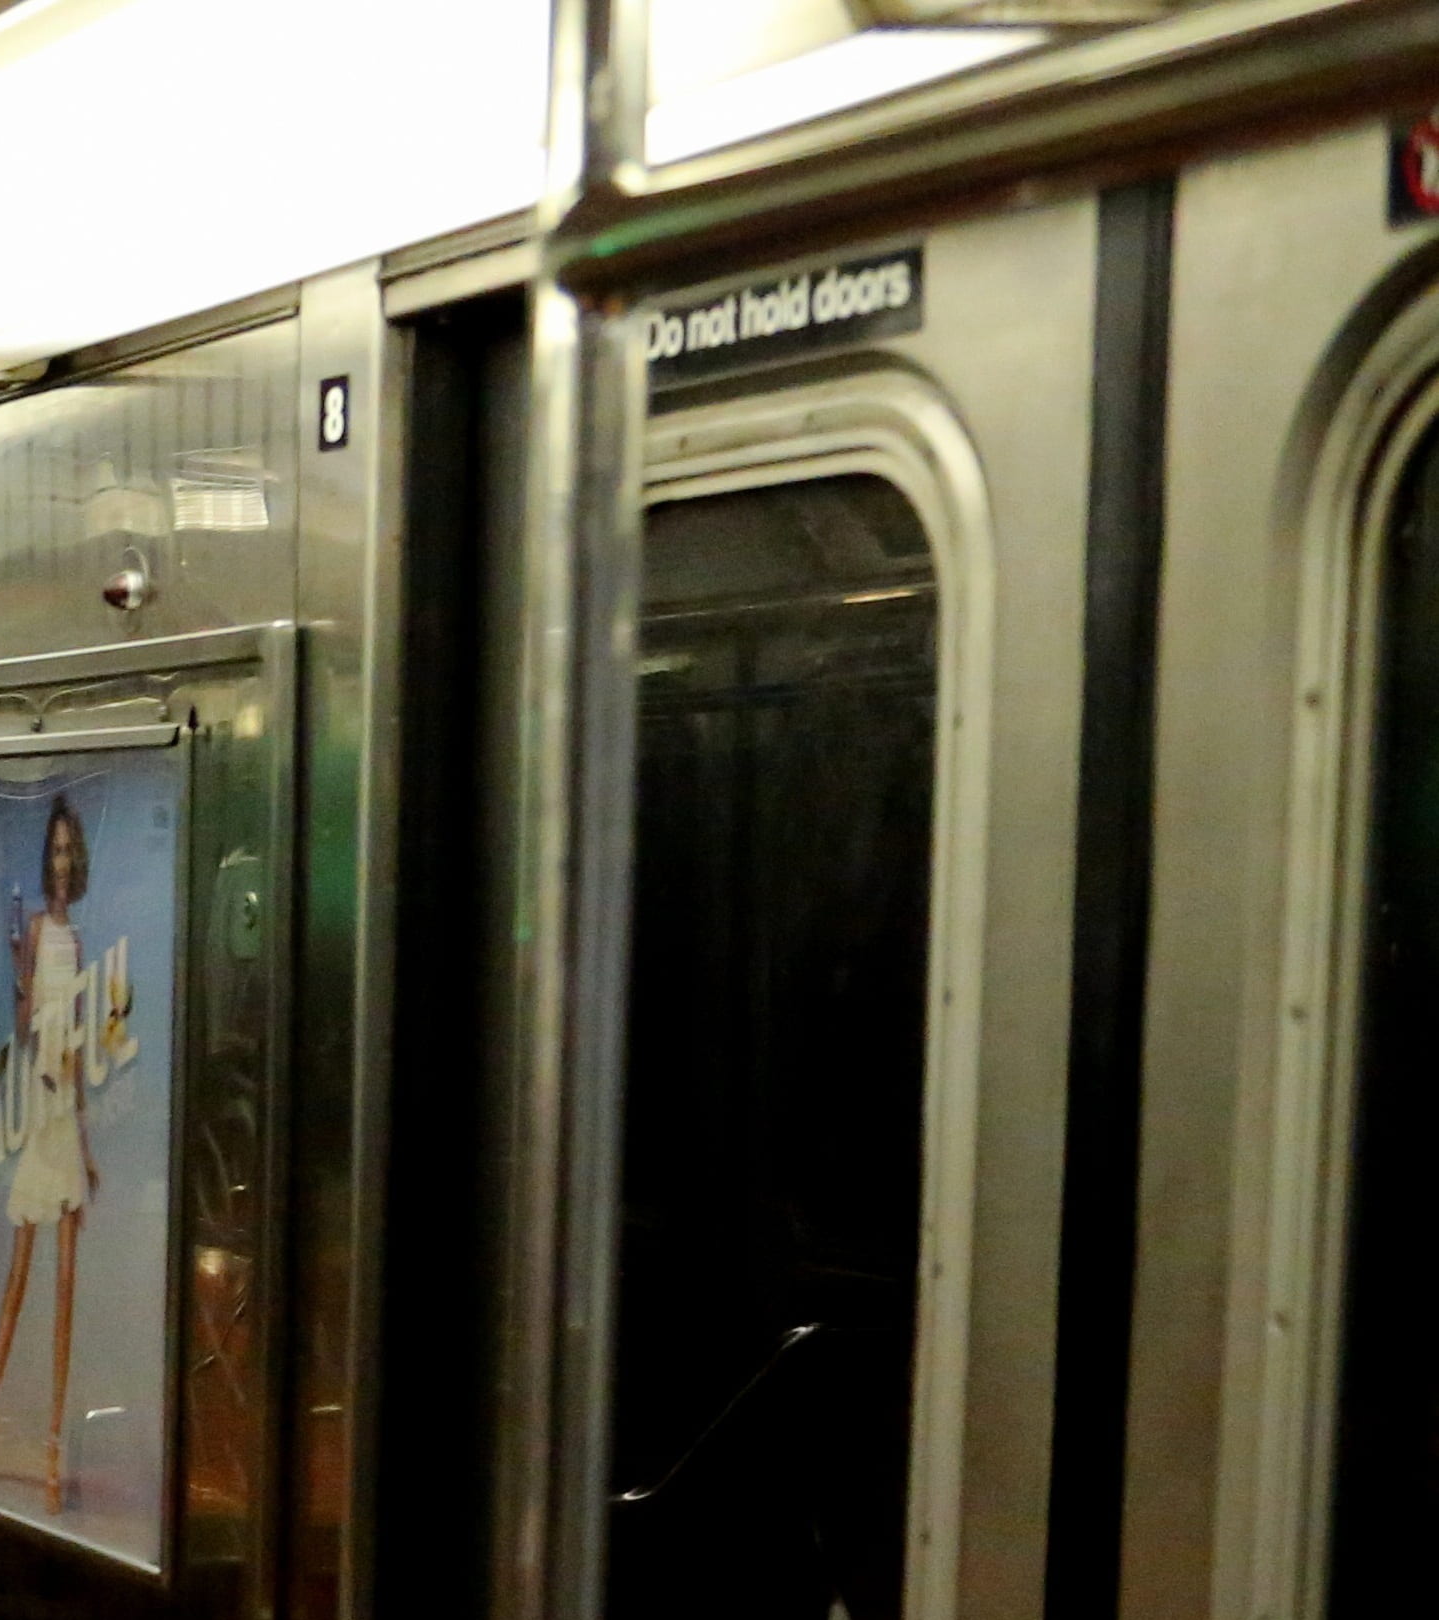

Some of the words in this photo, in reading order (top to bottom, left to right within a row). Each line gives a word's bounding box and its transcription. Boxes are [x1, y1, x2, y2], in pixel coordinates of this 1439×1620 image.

[646, 309, 684, 362] Do
[686, 293, 736, 351] not
[739, 273, 810, 340] hold
[812, 260, 912, 324] doors
[324, 386, 345, 443] 8
